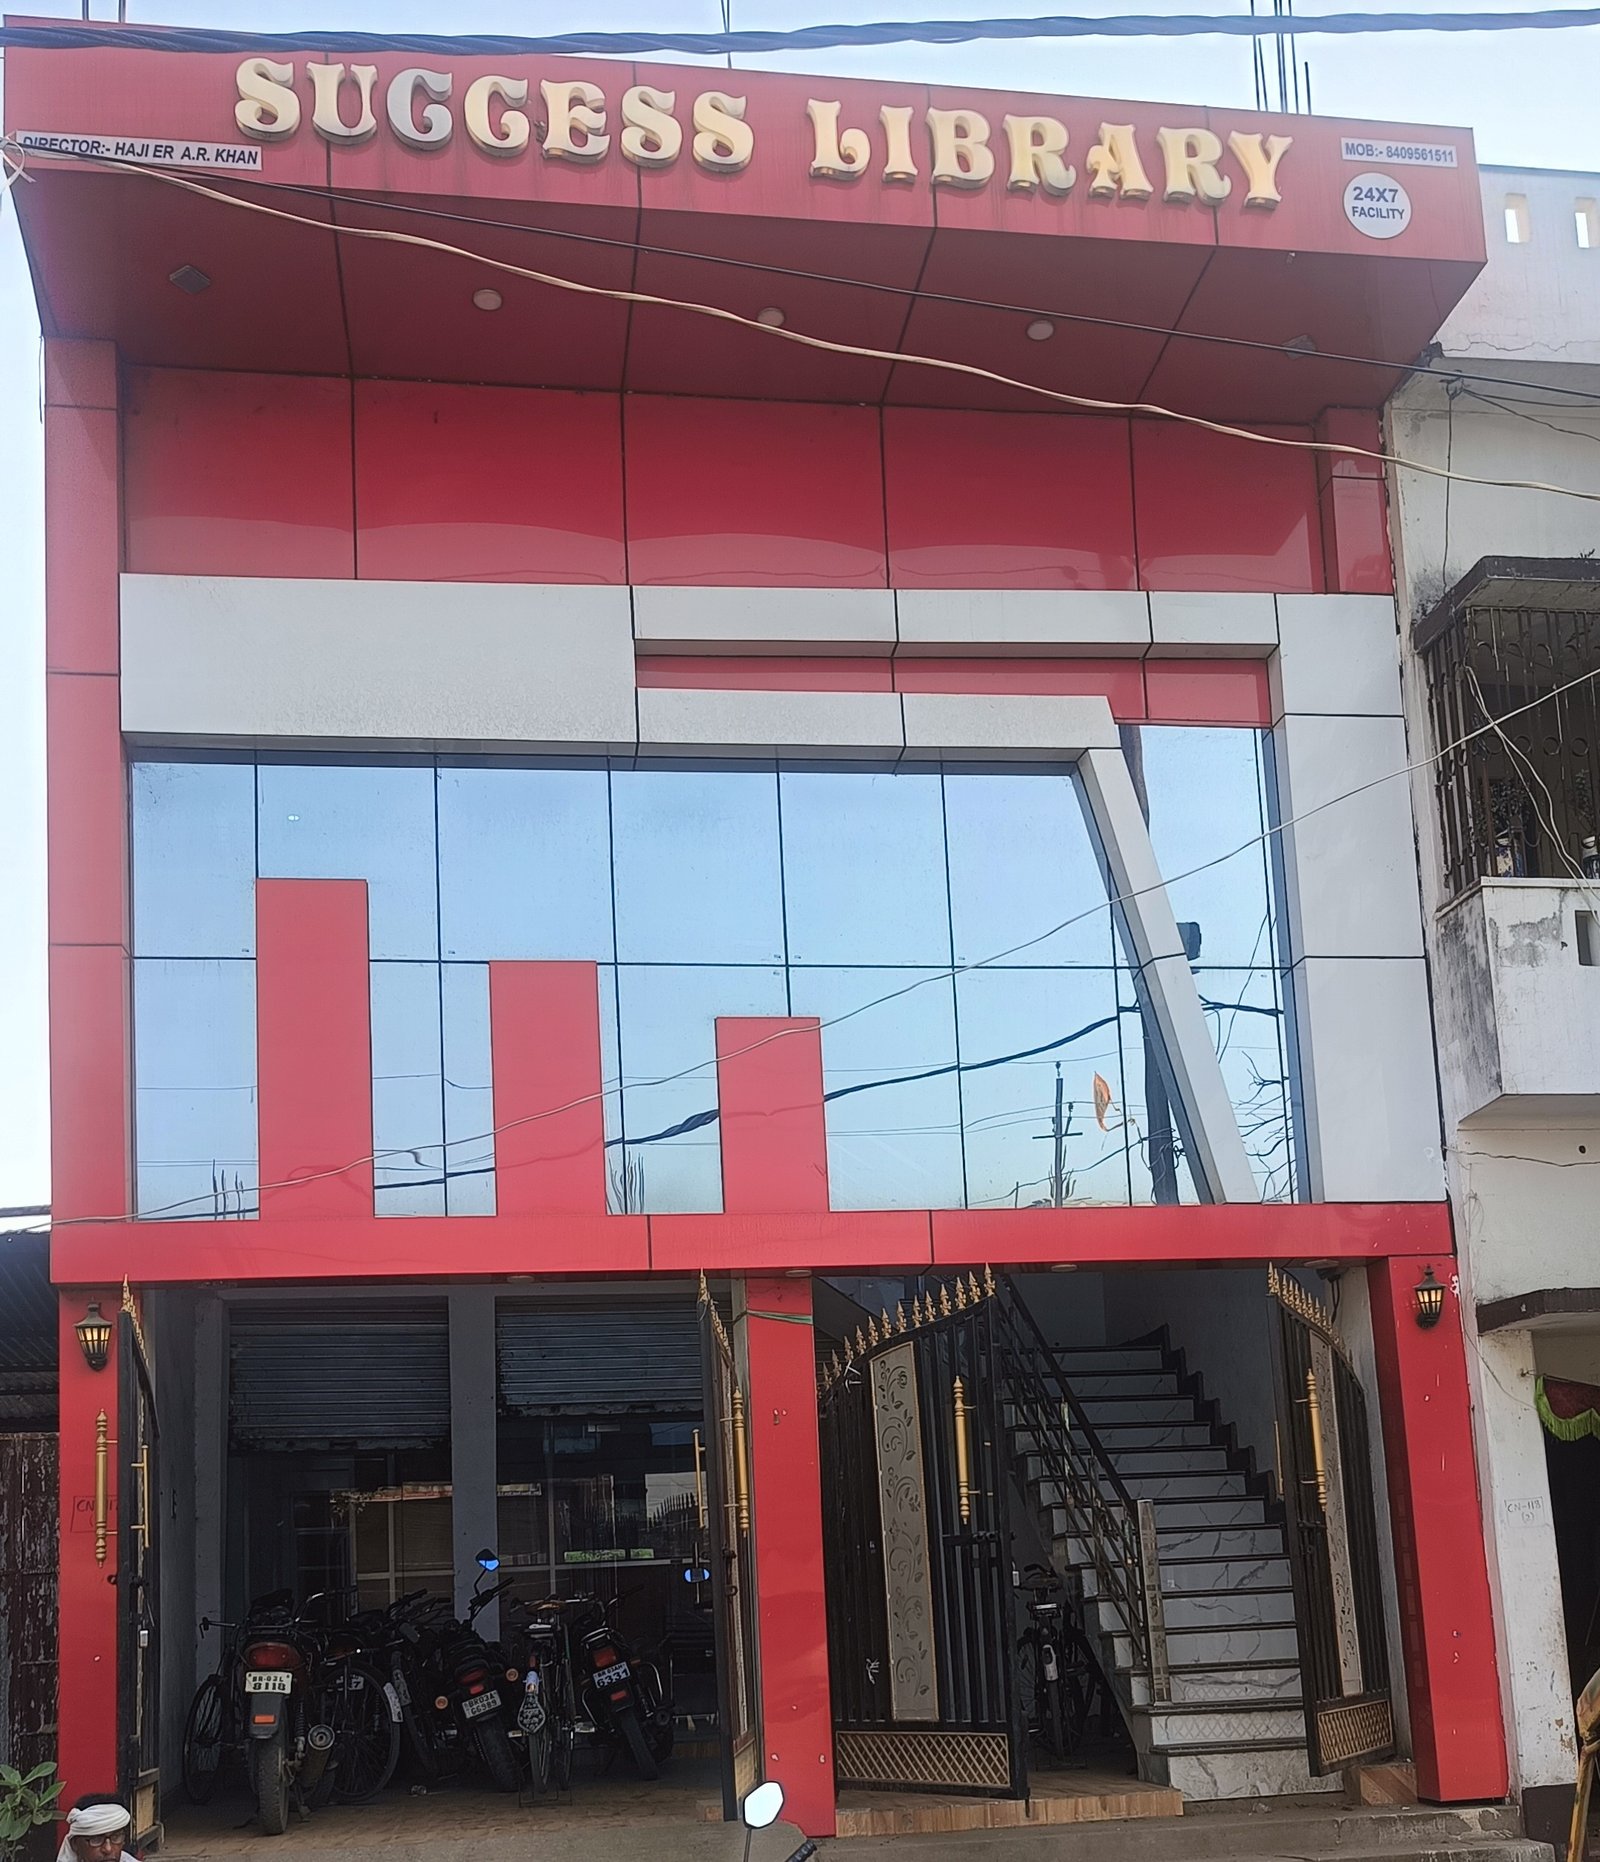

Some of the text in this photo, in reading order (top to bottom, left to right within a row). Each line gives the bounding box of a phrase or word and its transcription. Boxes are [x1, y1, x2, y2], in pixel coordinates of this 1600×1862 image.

[234, 57, 1294, 210] SUCCESS LIBRARY
[114, 142, 150, 158] HAJI
[153, 144, 174, 160] ER
[180, 146, 210, 162] A.R.
[214, 148, 259, 165] KHAN
[1344, 142, 1455, 163] MOB:- 8409561511
[1352, 186, 1400, 203] 24X7
[1351, 206, 1406, 220] FACILITY
